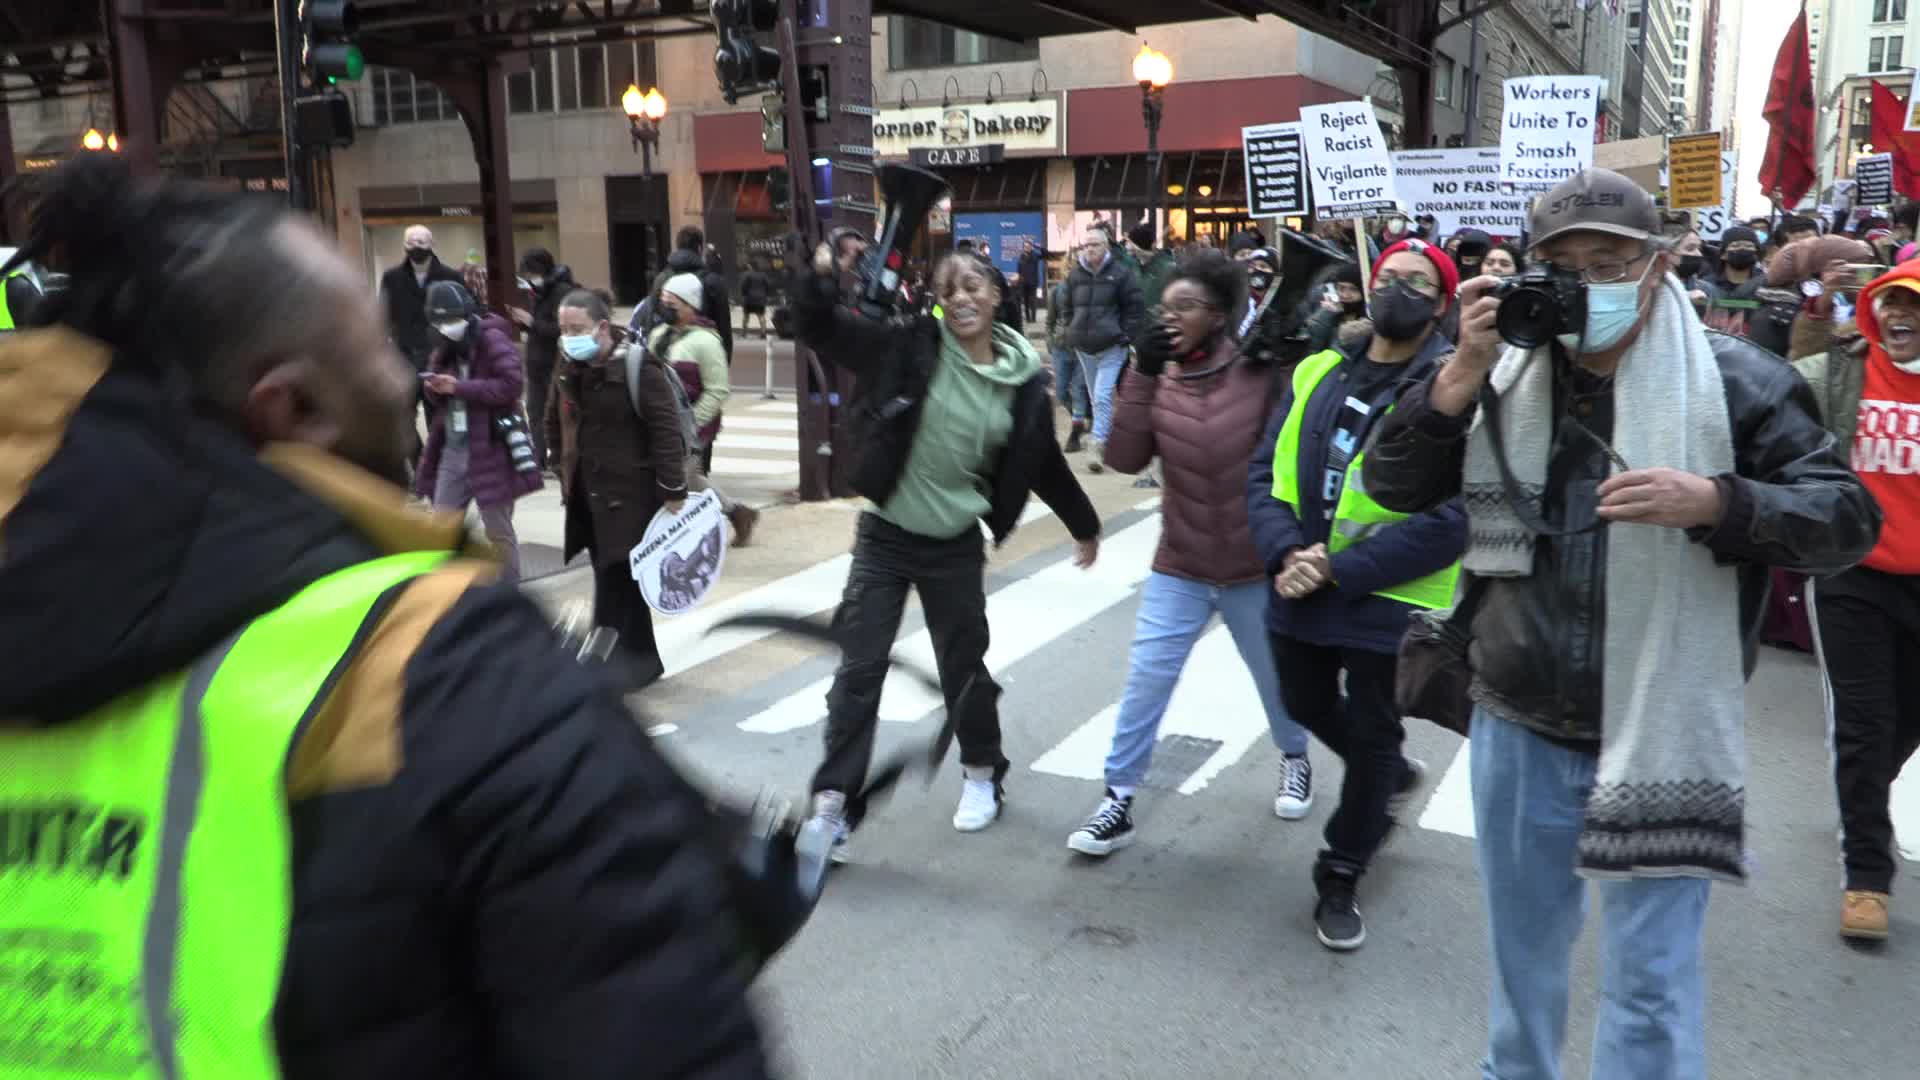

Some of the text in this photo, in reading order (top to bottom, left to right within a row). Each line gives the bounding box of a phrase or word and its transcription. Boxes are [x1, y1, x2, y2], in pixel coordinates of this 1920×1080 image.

[1510, 82, 1592, 101] Workers
[873, 114, 1052, 138] orner bakery
[1320, 112, 1368, 132] Reject
[1508, 110, 1589, 129] Unite To
[1324, 134, 1373, 152] Racist
[1515, 141, 1577, 159] Smash
[927, 149, 980, 165] CAFE
[1316, 164, 1387, 185] Vigilante
[1396, 164, 1500, 176] Rittenhouse-GUILT
[1507, 160, 1583, 179] Fascism!
[1327, 186, 1384, 202] Terror
[1434, 182, 1458, 194] NO
[1464, 180, 1500, 193] FAS
[1416, 201, 1486, 212] ORGANIZE
[1490, 199, 1521, 211] NOW
[1550, 193, 1624, 215] STOLEN
[1459, 215, 1525, 226] REVOLUT
[1852, 438, 1920, 475] MAD
[633, 533, 669, 567] AMEENA
[668, 496, 713, 537] MATTHEWS
